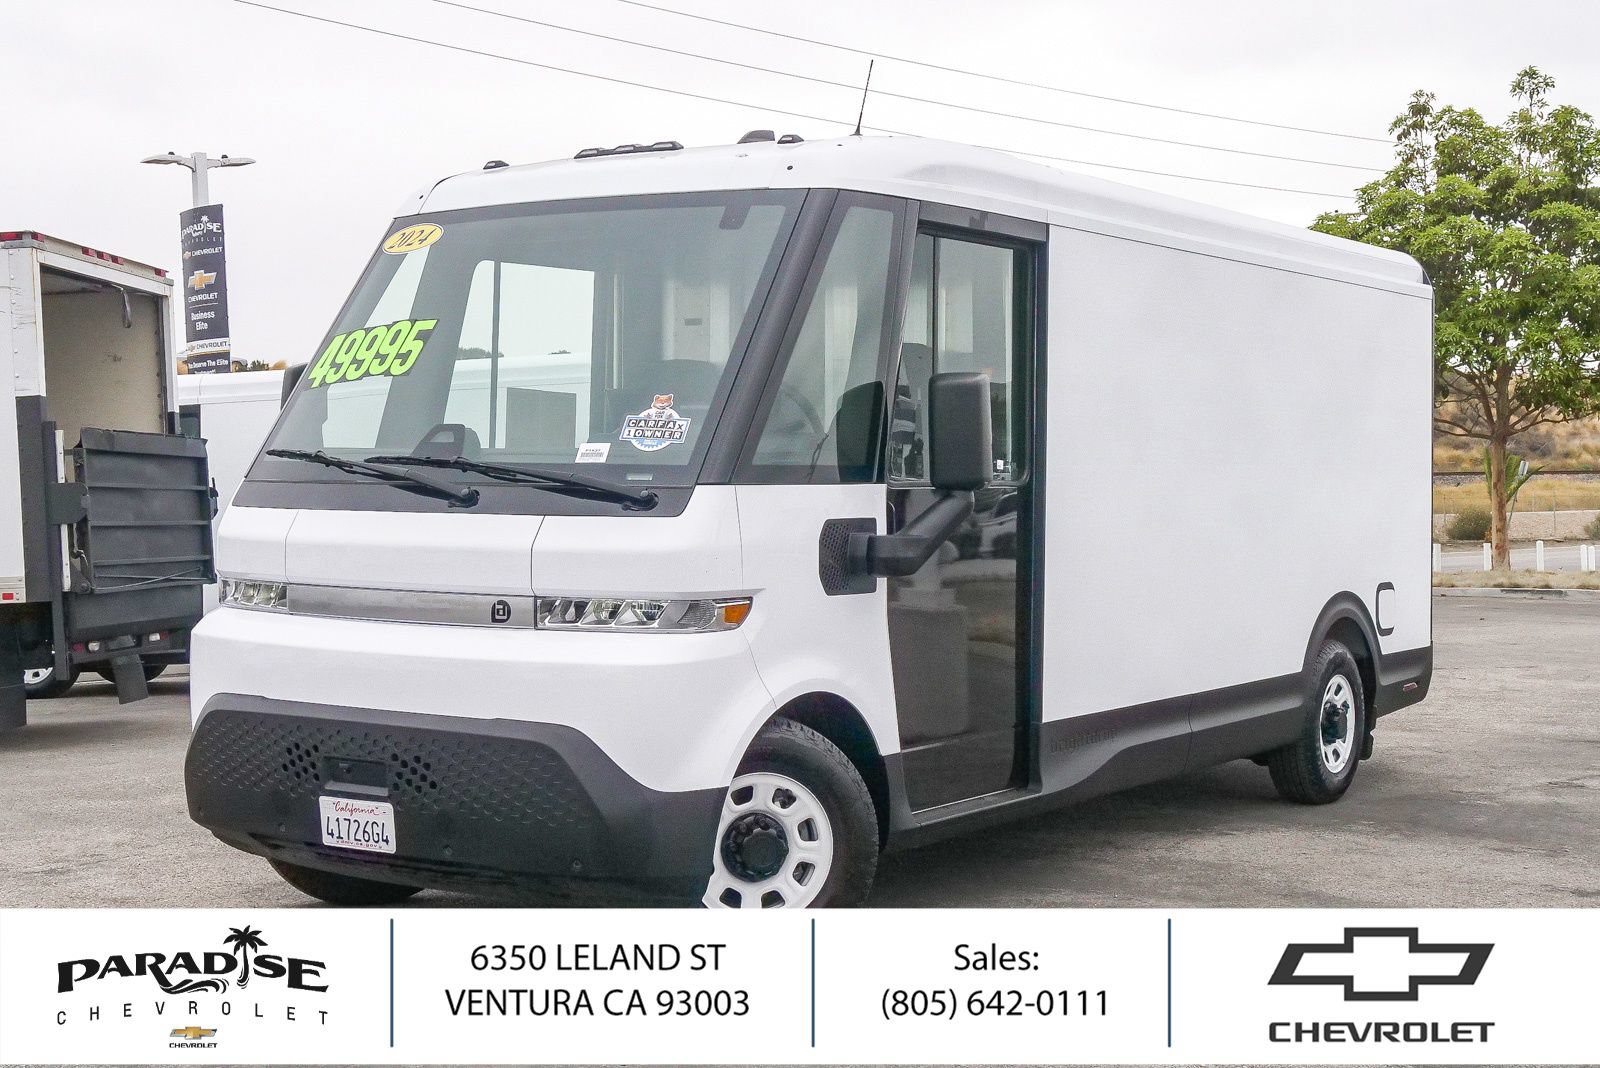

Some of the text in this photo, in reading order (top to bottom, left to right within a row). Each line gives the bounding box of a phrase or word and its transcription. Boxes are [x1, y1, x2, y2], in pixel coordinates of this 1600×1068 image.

[182, 218, 222, 239] PARADISE
[387, 228, 437, 250] 2024
[191, 247, 223, 256] CHEVROLET
[188, 292, 218, 303] CHEVROLET
[191, 311, 215, 321] Business
[196, 321, 209, 331] Elite
[197, 341, 227, 349] CHEVROLET
[308, 319, 438, 388] 49995
[207, 359, 216, 367] The
[216, 358, 229, 366] Elite
[629, 419, 684, 430] CARFAX
[335, 801, 379, 816] California
[326, 816, 389, 845] 41726G4
